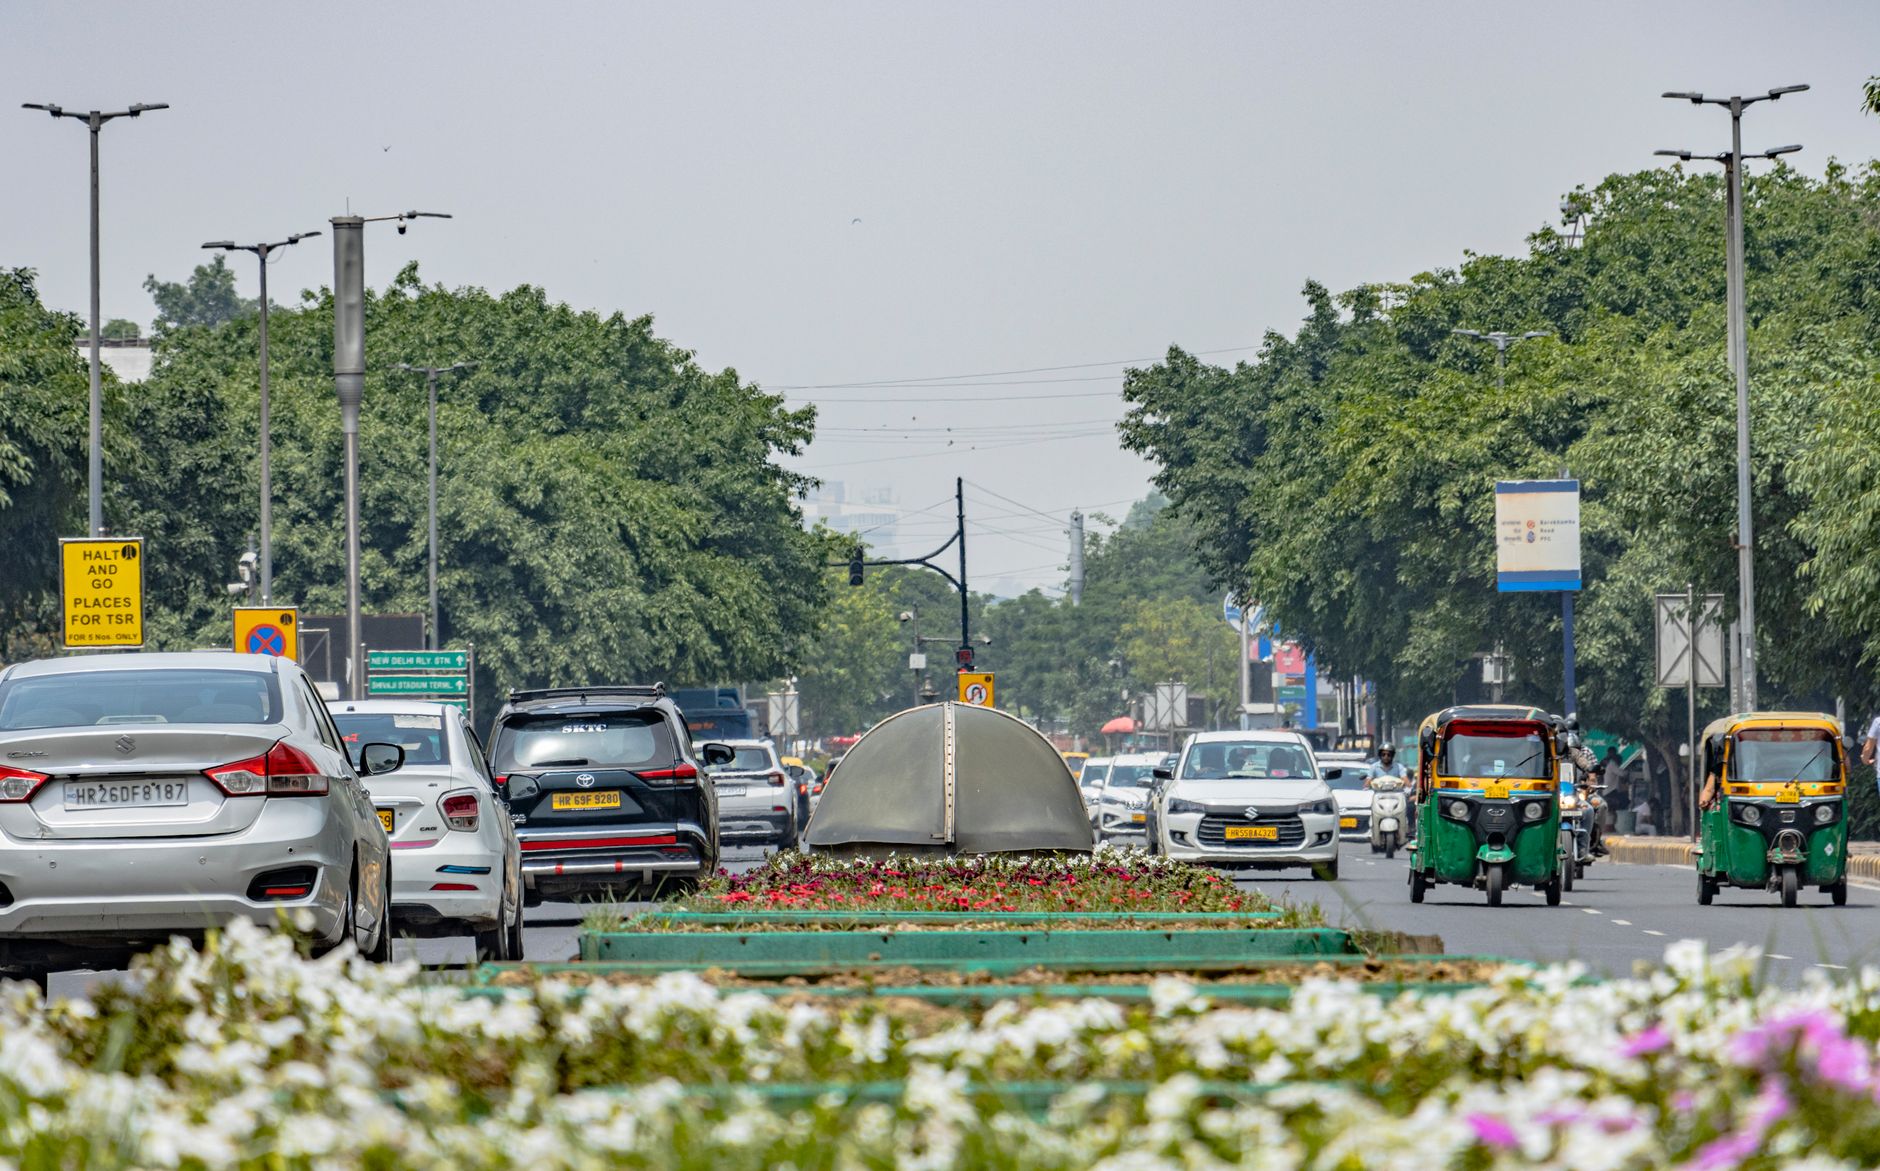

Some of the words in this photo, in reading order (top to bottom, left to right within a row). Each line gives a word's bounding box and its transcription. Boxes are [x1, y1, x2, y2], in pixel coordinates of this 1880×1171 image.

[83, 550, 119, 560] HALT
[87, 565, 118, 575] AND
[91, 579, 113, 589] GO
[73, 597, 132, 608] PLACES
[71, 614, 101, 625] FOR
[106, 614, 135, 625] TSR
[68, 633, 86, 641] FOR
[371, 657, 389, 665] NEW
[391, 656, 415, 665] DELHI
[398, 681, 428, 689] STADIUM
[76, 784, 185, 804] HR26DF8187
[558, 795, 571, 806] HR
[573, 794, 592, 806] 69F
[594, 793, 619, 805] 9280
